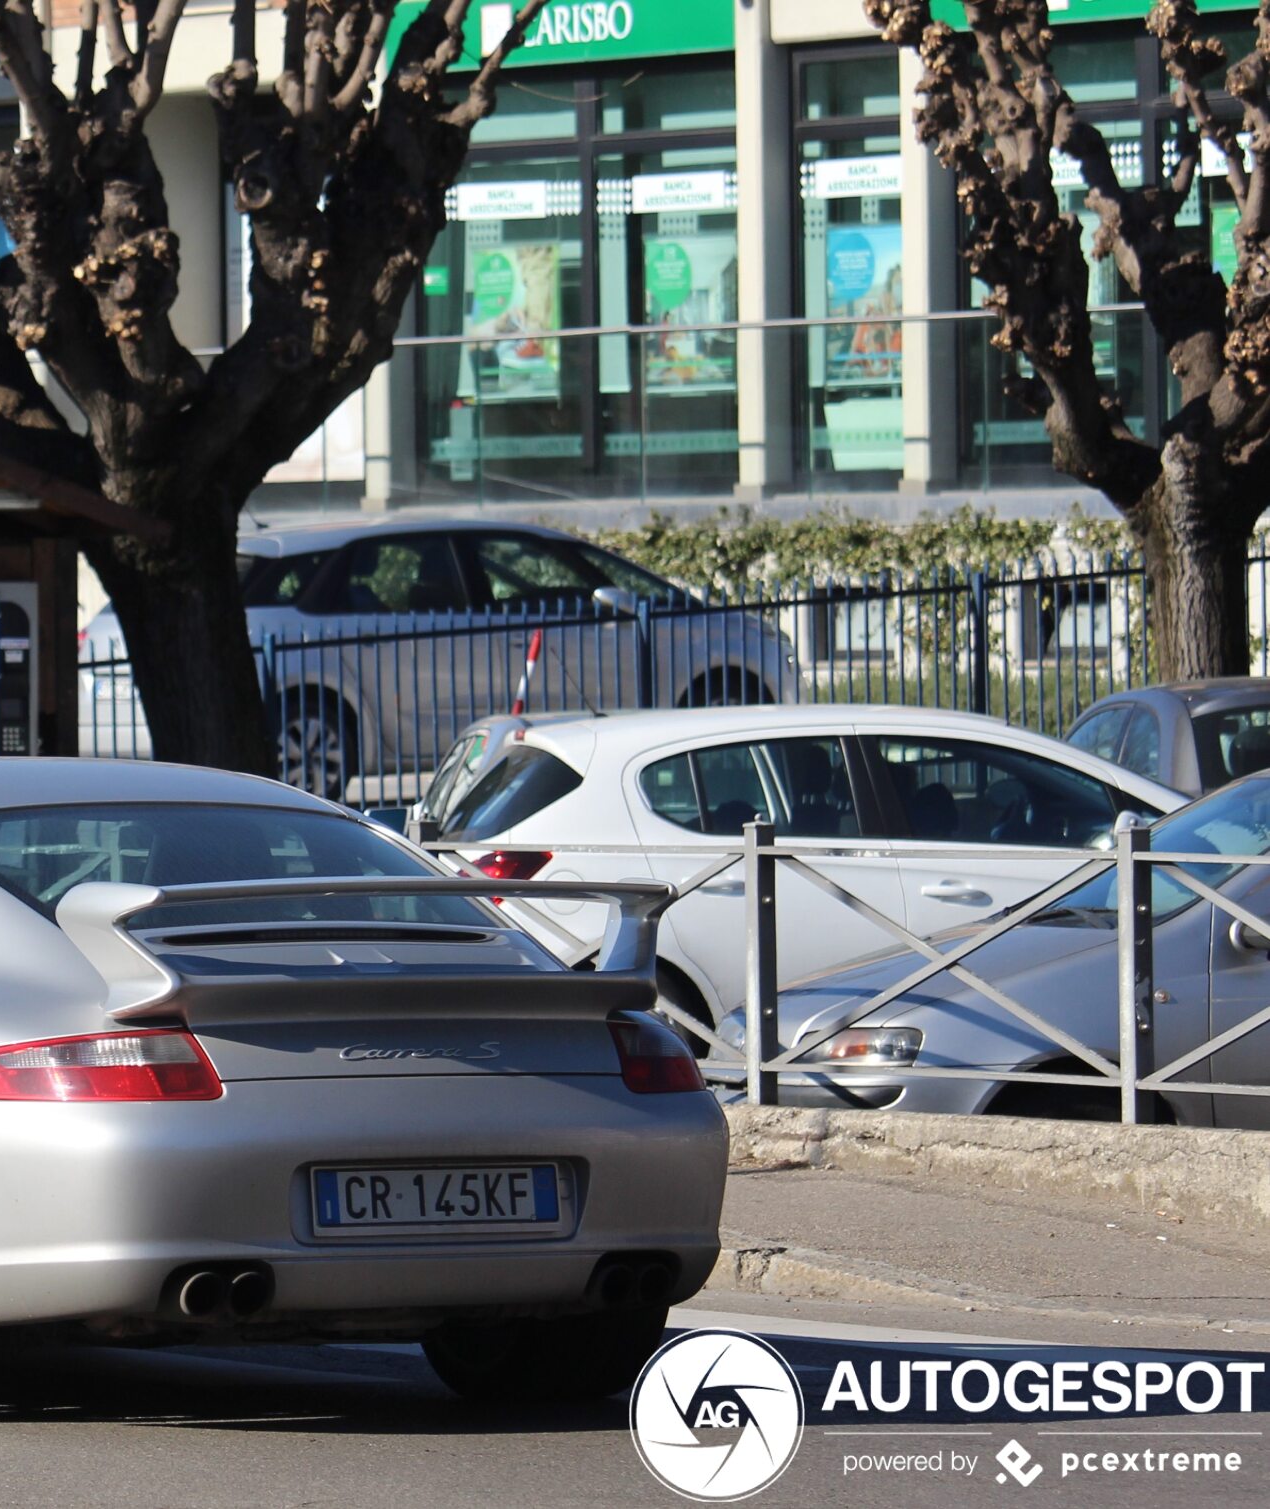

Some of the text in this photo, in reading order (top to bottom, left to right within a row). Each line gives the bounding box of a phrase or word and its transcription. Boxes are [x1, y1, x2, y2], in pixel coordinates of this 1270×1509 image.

[848, 165, 877, 176] BANCA
[664, 181, 692, 191] BANCA
[487, 189, 516, 199] BANCA
[339, 1042, 501, 1061] Carrera S
[345, 1173, 528, 1219] CR 145KF
